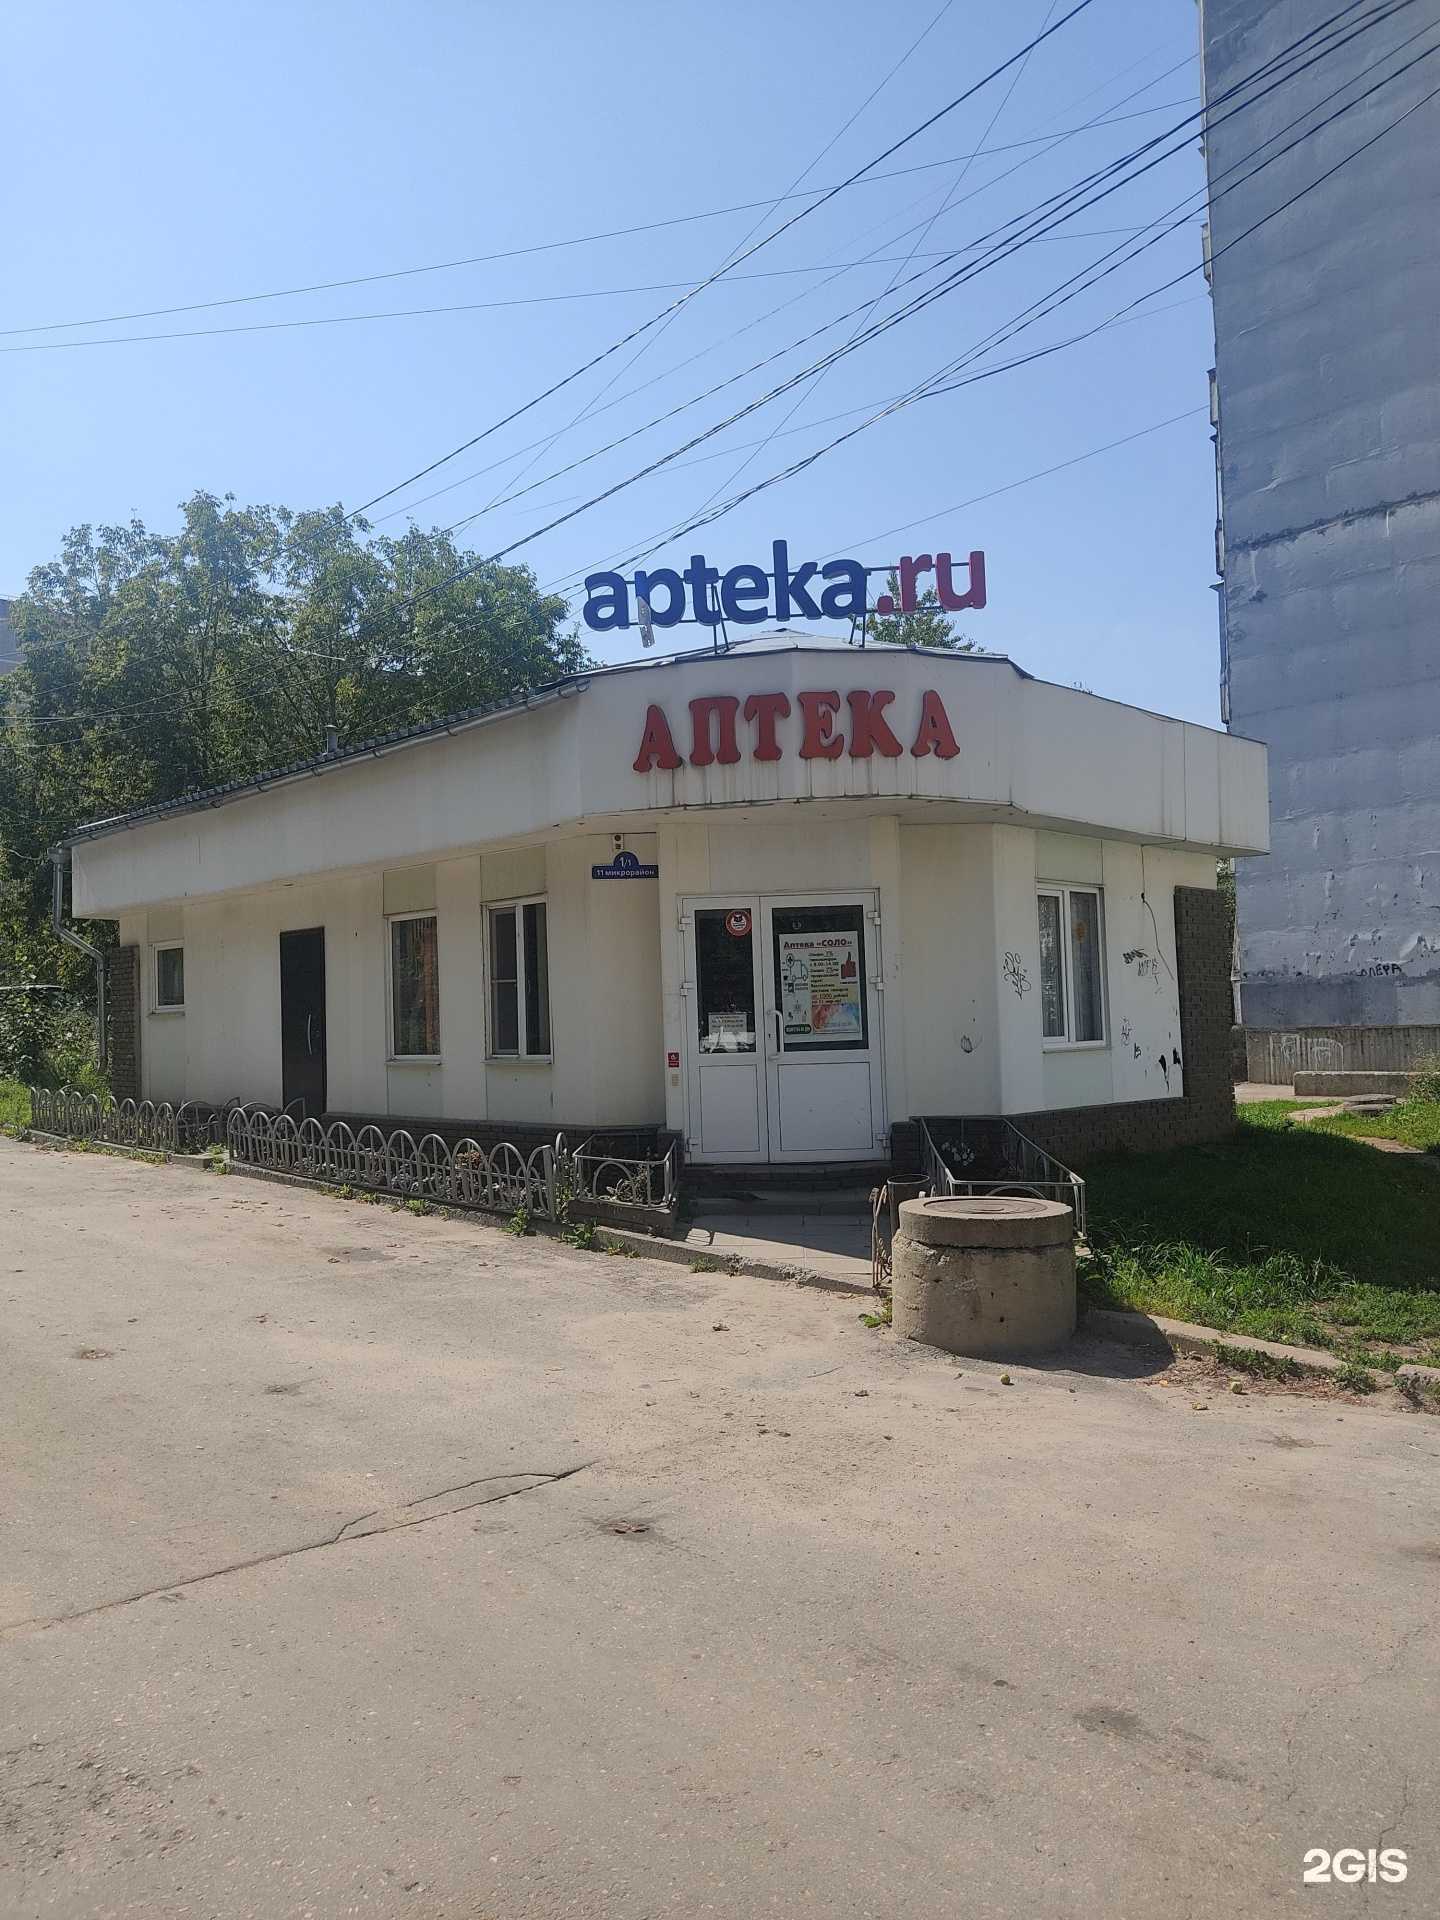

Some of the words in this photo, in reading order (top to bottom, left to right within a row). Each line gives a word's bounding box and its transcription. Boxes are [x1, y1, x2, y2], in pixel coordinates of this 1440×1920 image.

[583, 540, 987, 647] apteka.ru
[633, 690, 960, 773] АПТЕКА
[605, 869, 655, 877] микрорайон
